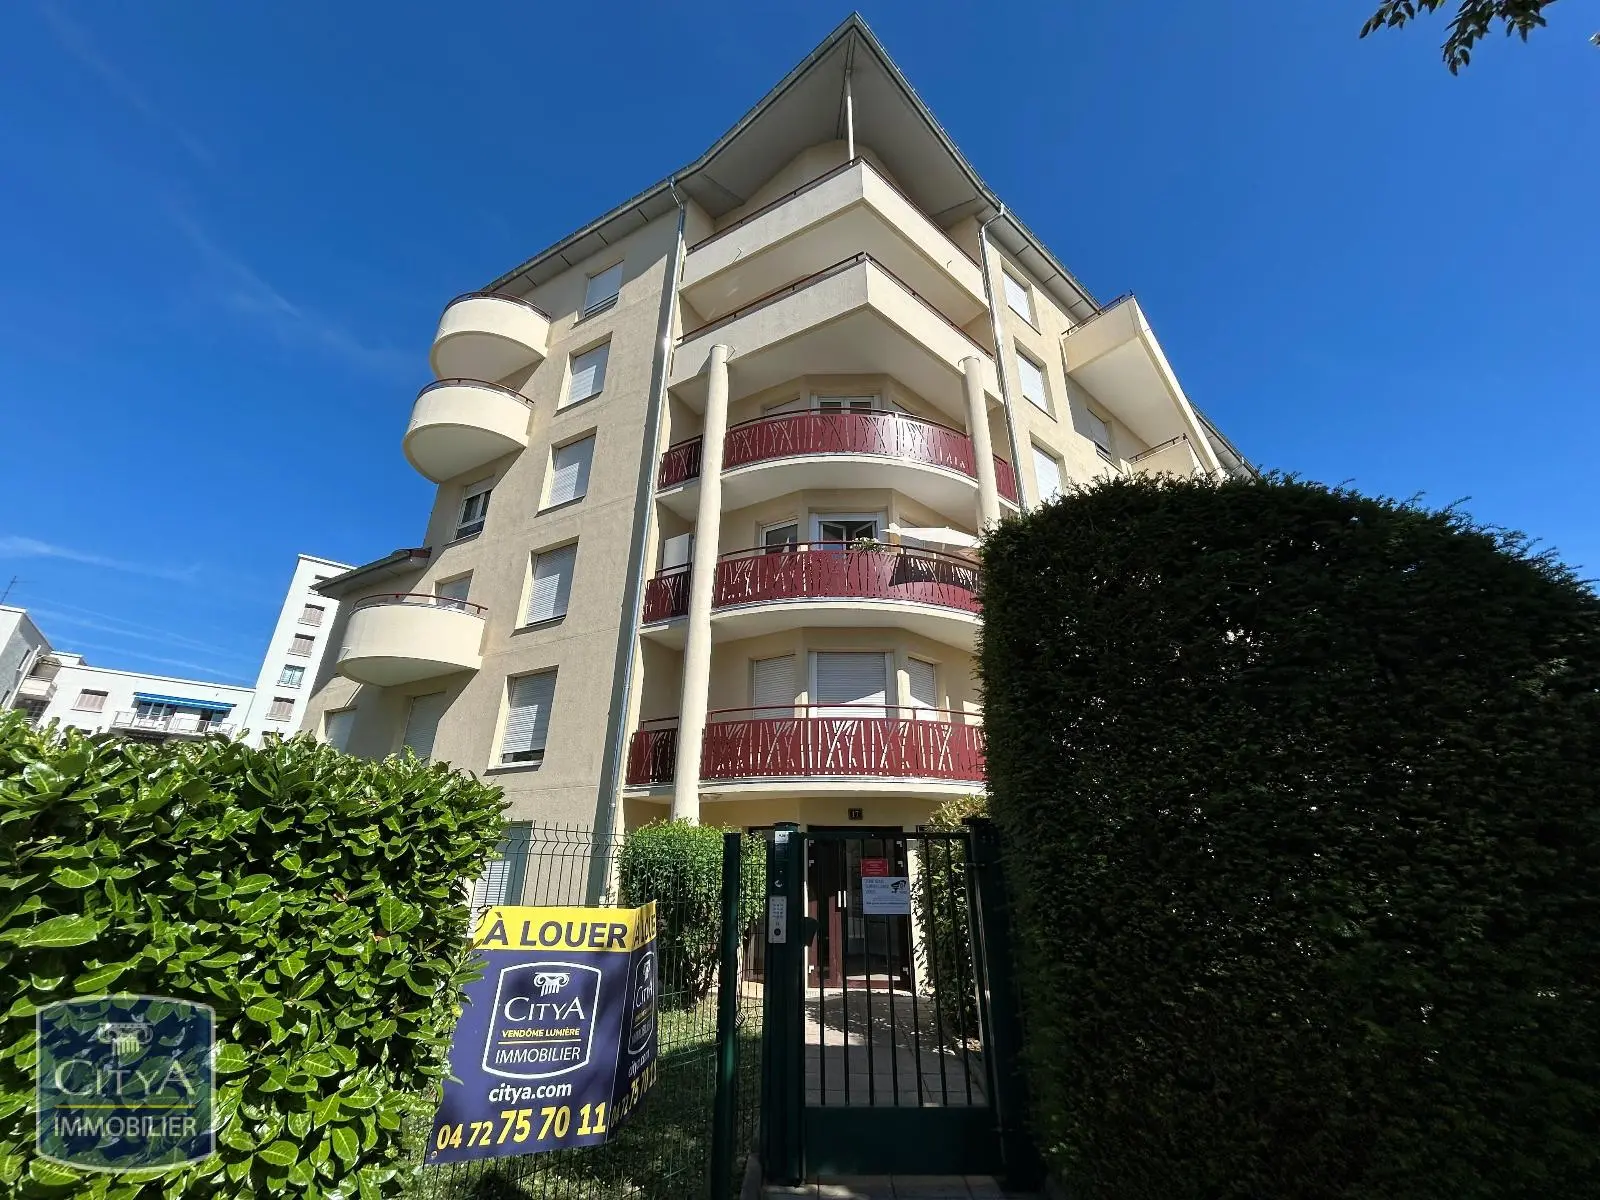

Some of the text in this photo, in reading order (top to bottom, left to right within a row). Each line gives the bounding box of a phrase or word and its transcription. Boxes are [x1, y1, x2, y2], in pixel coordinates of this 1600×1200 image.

[483, 911, 628, 948] À LOUER
[502, 1026, 580, 1038] VENDÔME LUMIÈRE
[495, 1046, 581, 1064] IMMOBILIER
[488, 1082, 572, 1104] citya.com
[436, 1102, 607, 1150] 04 72 75 70 11
